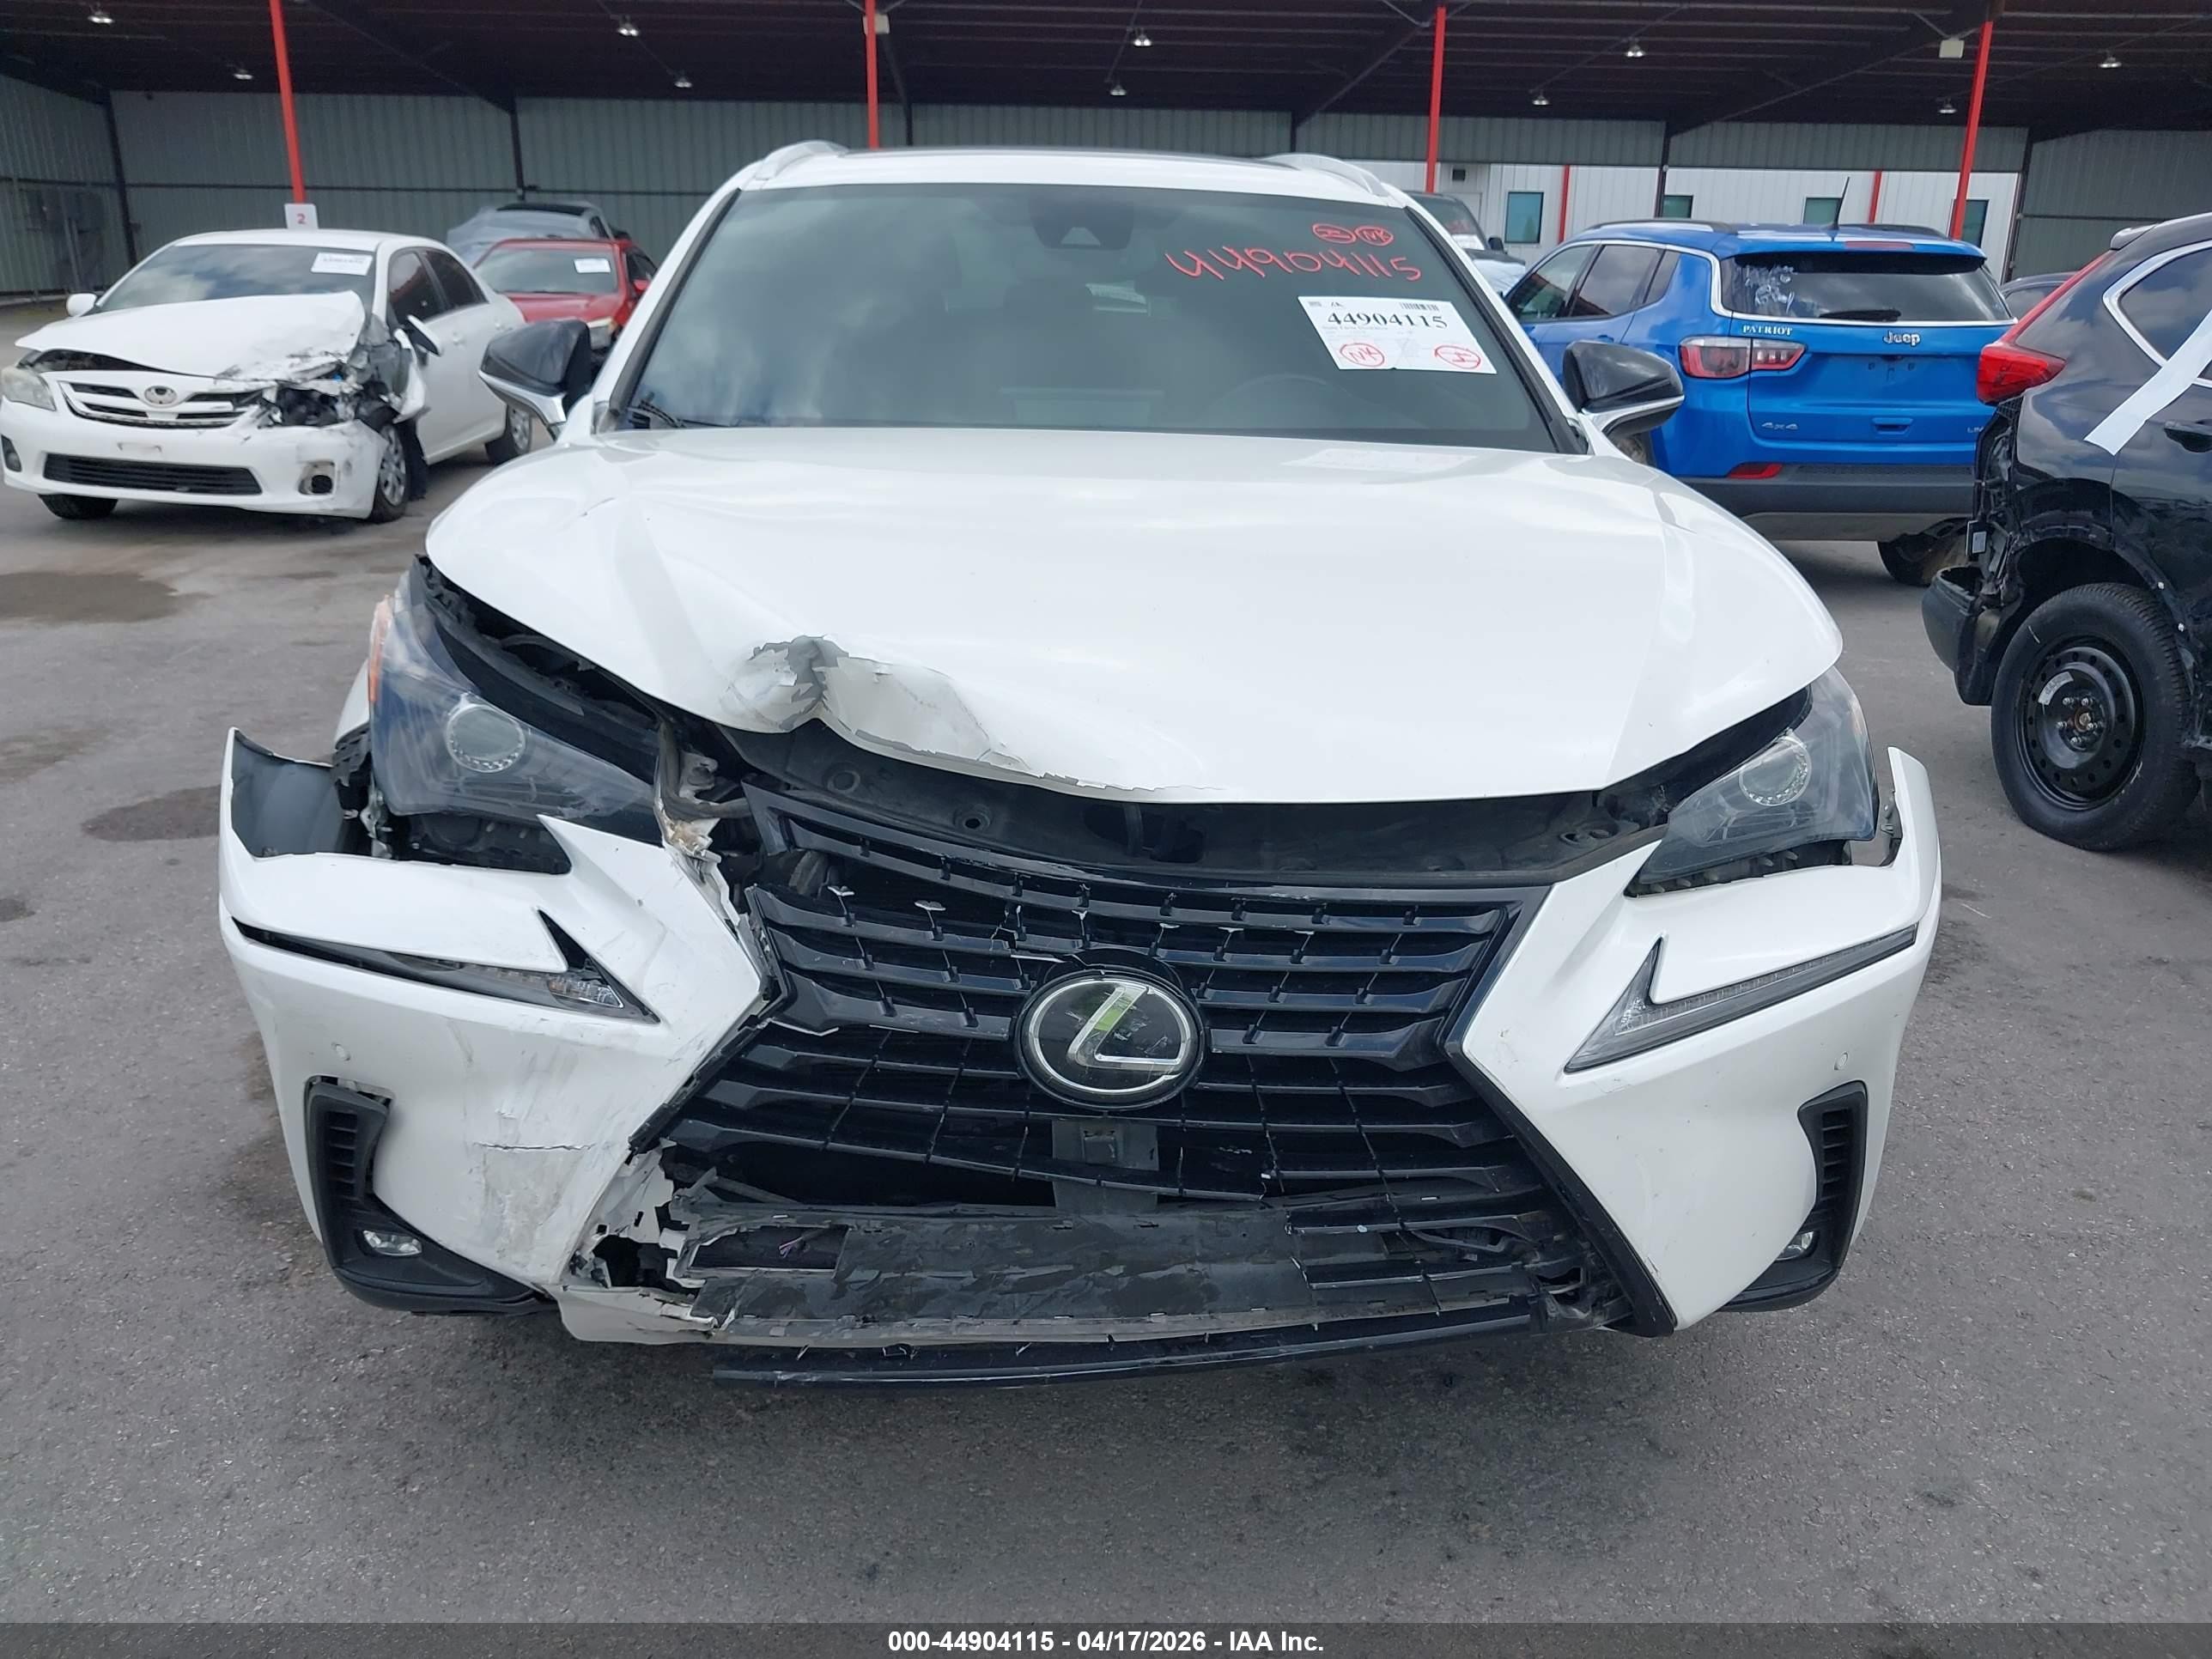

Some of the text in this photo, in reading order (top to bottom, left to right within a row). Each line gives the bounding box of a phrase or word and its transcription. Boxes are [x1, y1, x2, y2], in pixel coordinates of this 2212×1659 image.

[296, 213, 306, 224] 2
[1164, 246, 1421, 281] 44904115
[1328, 313, 1448, 329] 44904115
[1742, 325, 1792, 336] PATRIOT
[1883, 331, 1920, 346] Jeep
